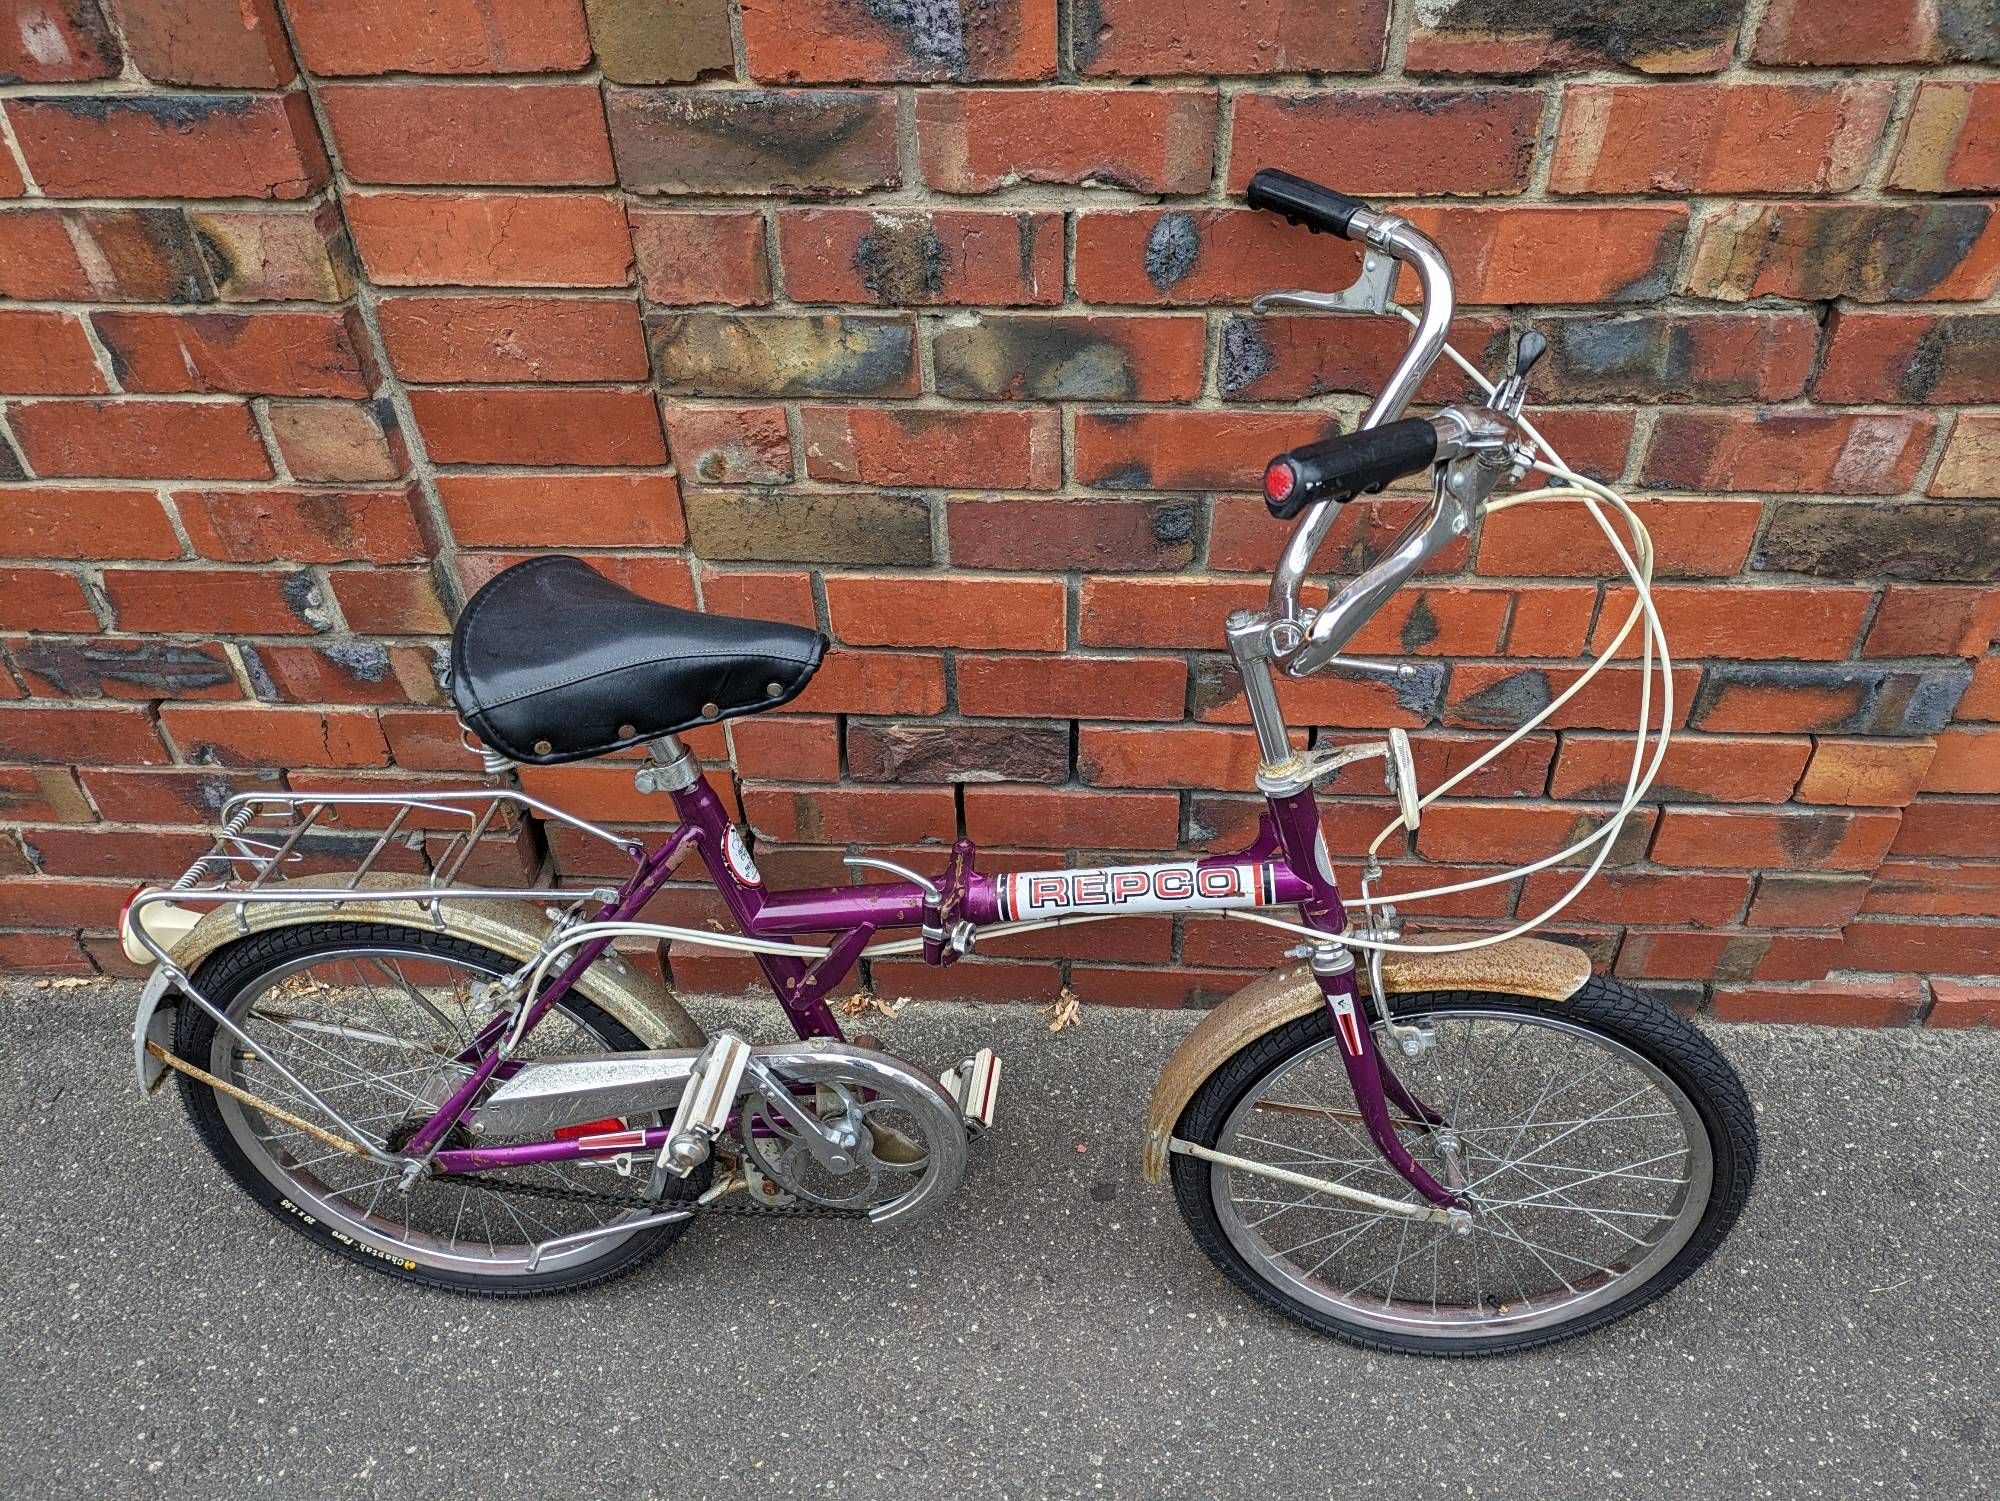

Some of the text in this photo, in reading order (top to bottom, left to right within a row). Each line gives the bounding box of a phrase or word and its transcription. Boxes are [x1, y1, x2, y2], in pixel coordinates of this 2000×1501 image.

[1029, 867, 1240, 908] REPCO
[280, 1199, 298, 1213] 1.95
[303, 1214, 316, 1225] 20
[332, 1230, 354, 1247] Furo
